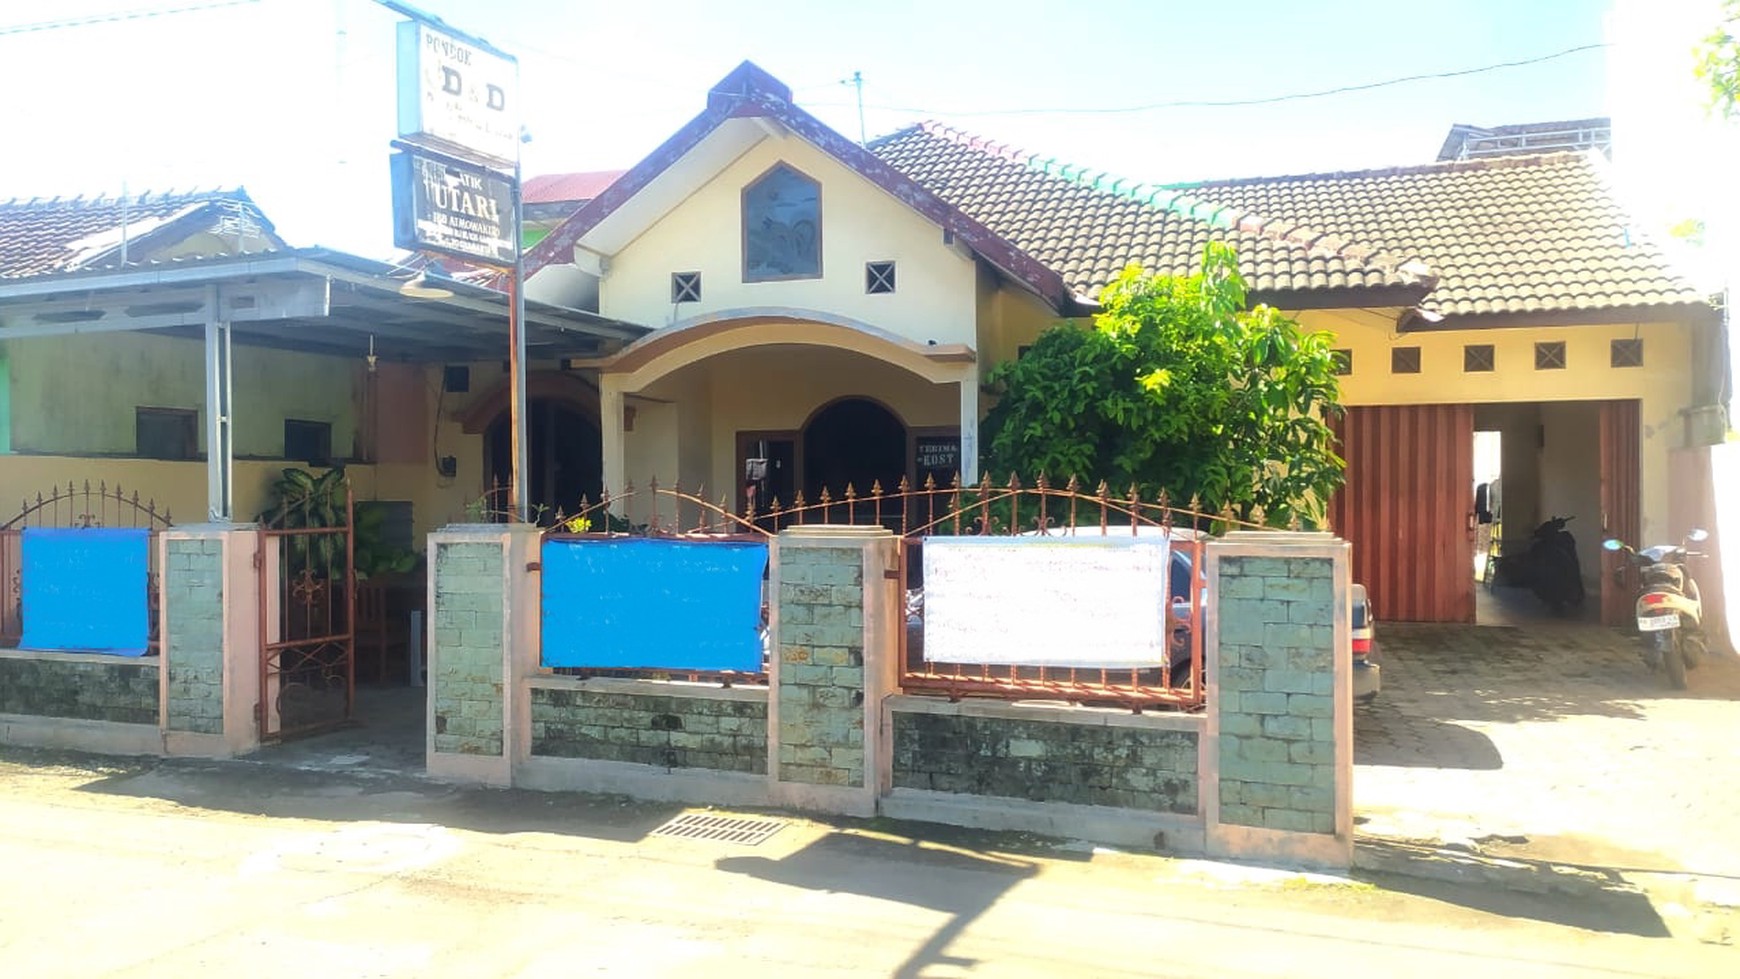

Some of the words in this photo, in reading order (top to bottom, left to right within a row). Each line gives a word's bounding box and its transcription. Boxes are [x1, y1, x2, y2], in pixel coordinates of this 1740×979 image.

[441, 64, 463, 97] D
[485, 82, 506, 112] D
[457, 171, 483, 191] ATIK
[431, 181, 500, 223] UTARI
[923, 453, 954, 467] KOST
